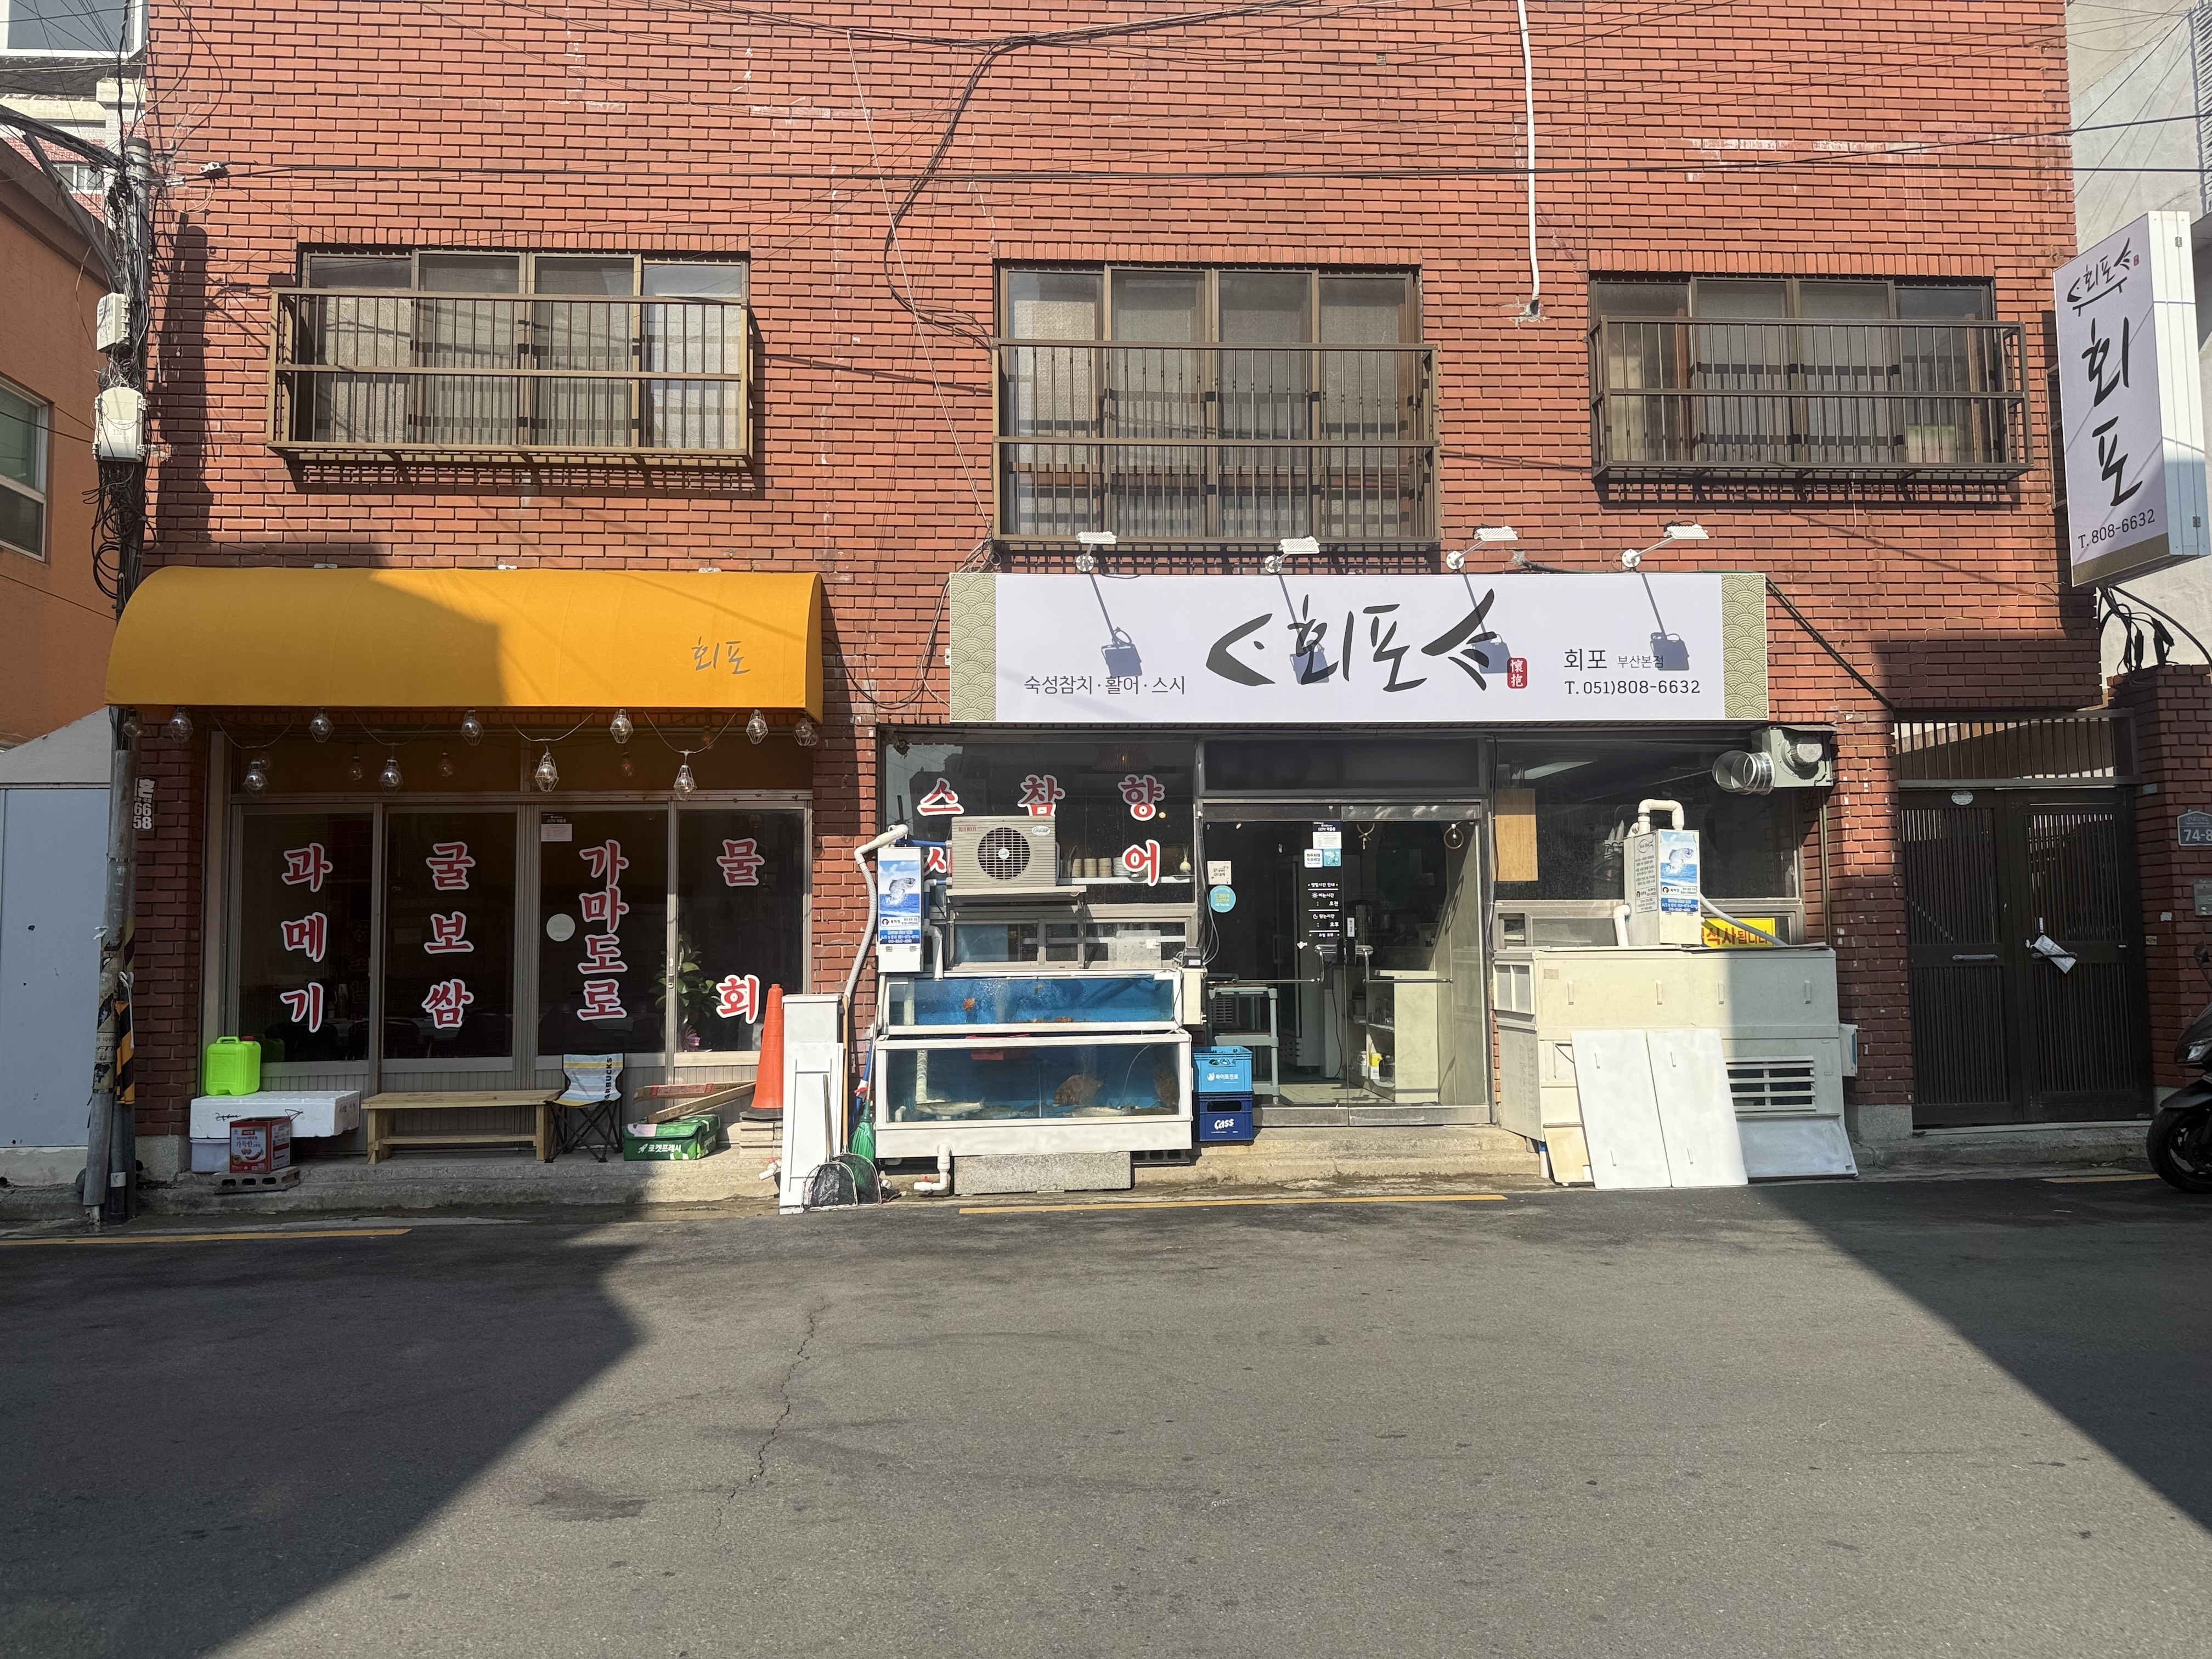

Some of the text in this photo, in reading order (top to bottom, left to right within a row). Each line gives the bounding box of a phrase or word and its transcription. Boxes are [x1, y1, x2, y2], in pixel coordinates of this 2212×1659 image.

[2083, 255, 2116, 293] 회포
[2081, 317, 2143, 506] 회포
[691, 636, 751, 675] 회포
[1564, 648, 1664, 672] 회포 부산본점
[1118, 774, 1166, 887] 향어
[280, 842, 334, 1034] 과메기
[421, 840, 476, 1029] 굴보쌈
[577, 839, 630, 1022] 가마도로
[715, 837, 766, 1024] 물회
[648, 1144, 681, 1153] 로켓프레시
[1214, 1118, 1234, 1130] Cass
